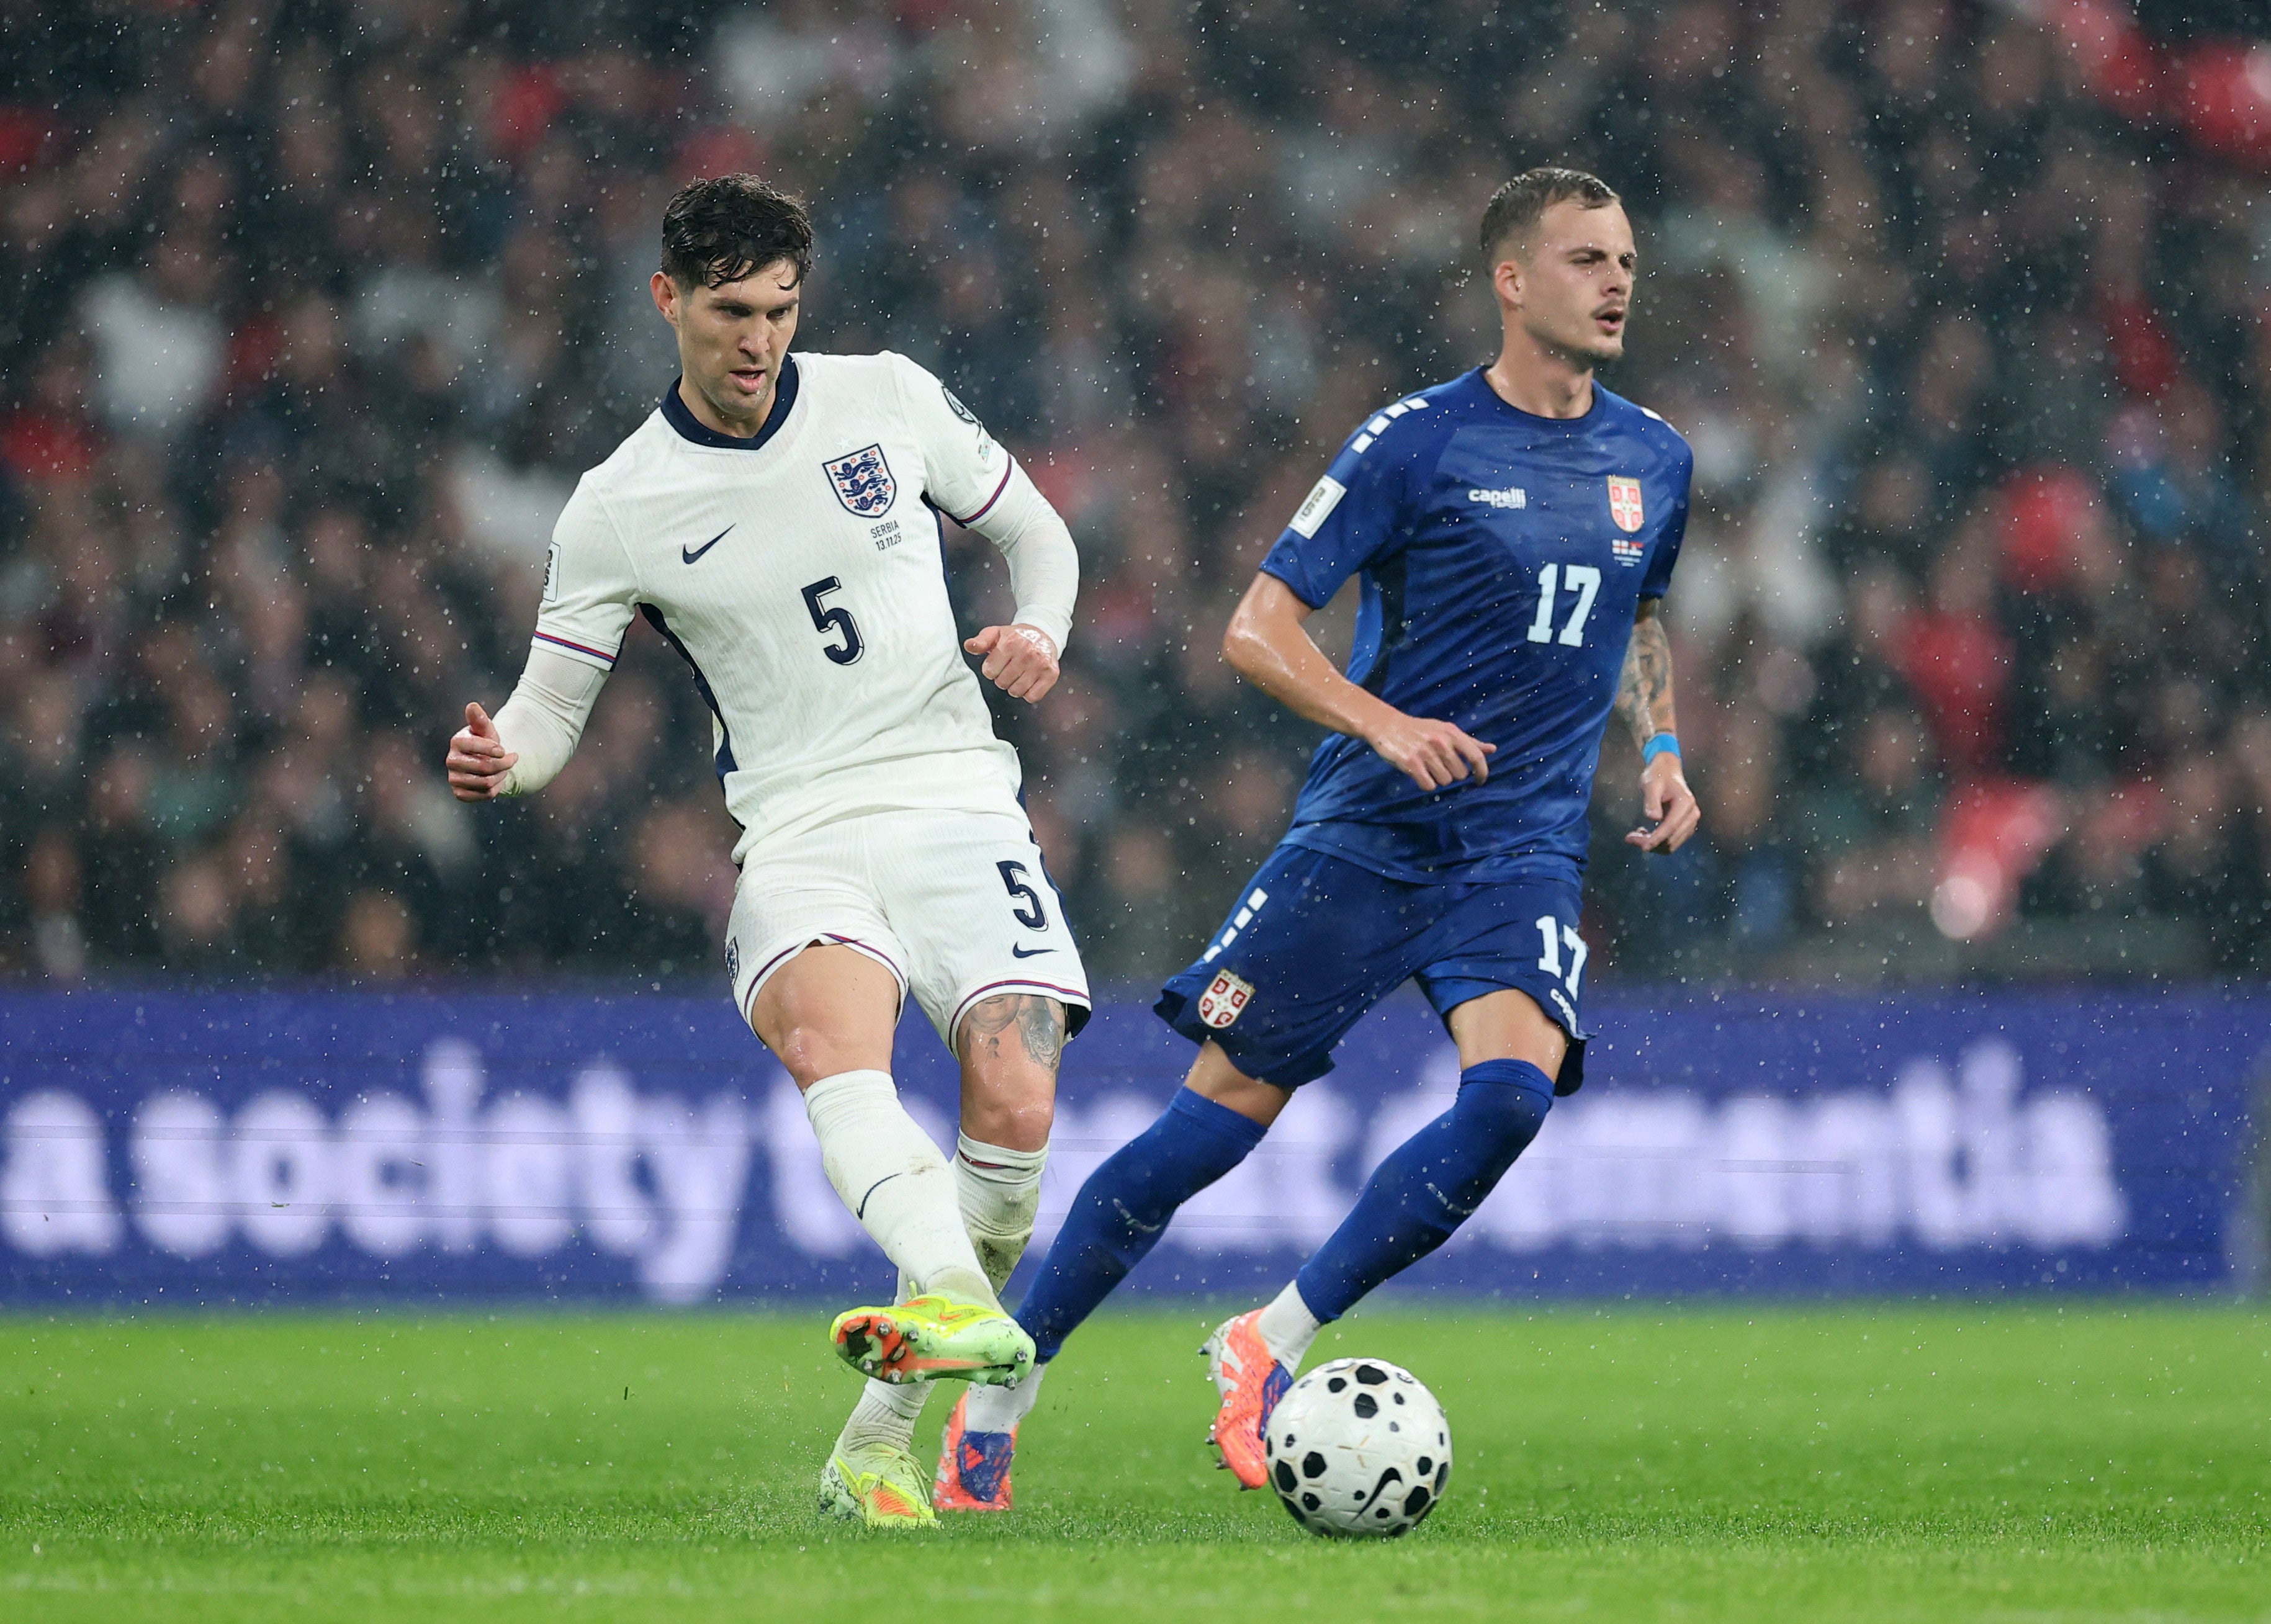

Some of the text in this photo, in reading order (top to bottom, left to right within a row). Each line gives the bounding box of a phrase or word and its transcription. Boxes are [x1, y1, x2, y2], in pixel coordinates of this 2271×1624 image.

[870, 519, 900, 539] SERBIA
[1468, 488, 1526, 508] capelli
[801, 575, 865, 665] 5
[1527, 563, 1601, 647] 17
[996, 860, 1049, 932] 5
[1535, 915, 1589, 1002] 17
[2, 1089, 119, 1254] a
[132, 1039, 747, 1302] society
